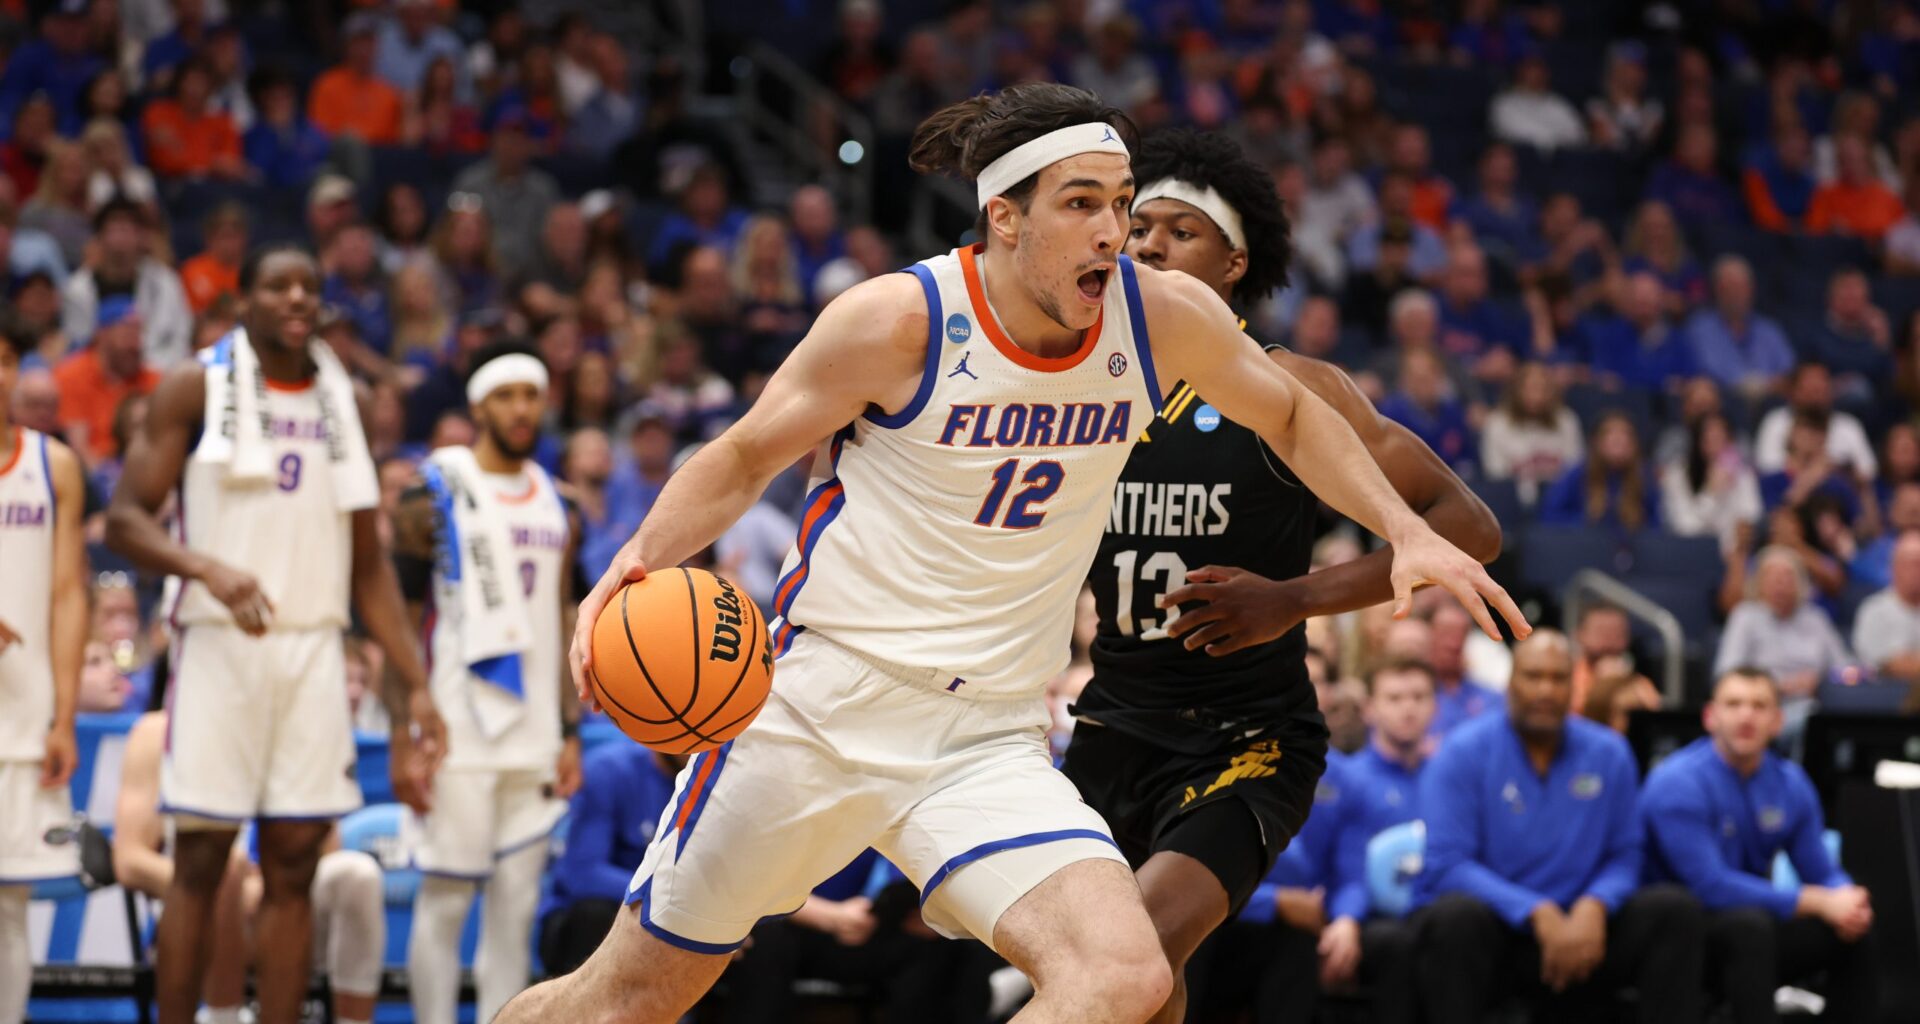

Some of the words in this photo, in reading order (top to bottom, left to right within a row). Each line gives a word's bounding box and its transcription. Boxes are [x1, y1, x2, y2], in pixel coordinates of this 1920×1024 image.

[1109, 354, 1126, 376] SEC
[936, 401, 1132, 447] FLORIDA
[278, 453, 302, 492] 9
[973, 458, 1066, 530] 12
[1106, 482, 1231, 536] NTHERS
[1113, 550, 1188, 641] 13
